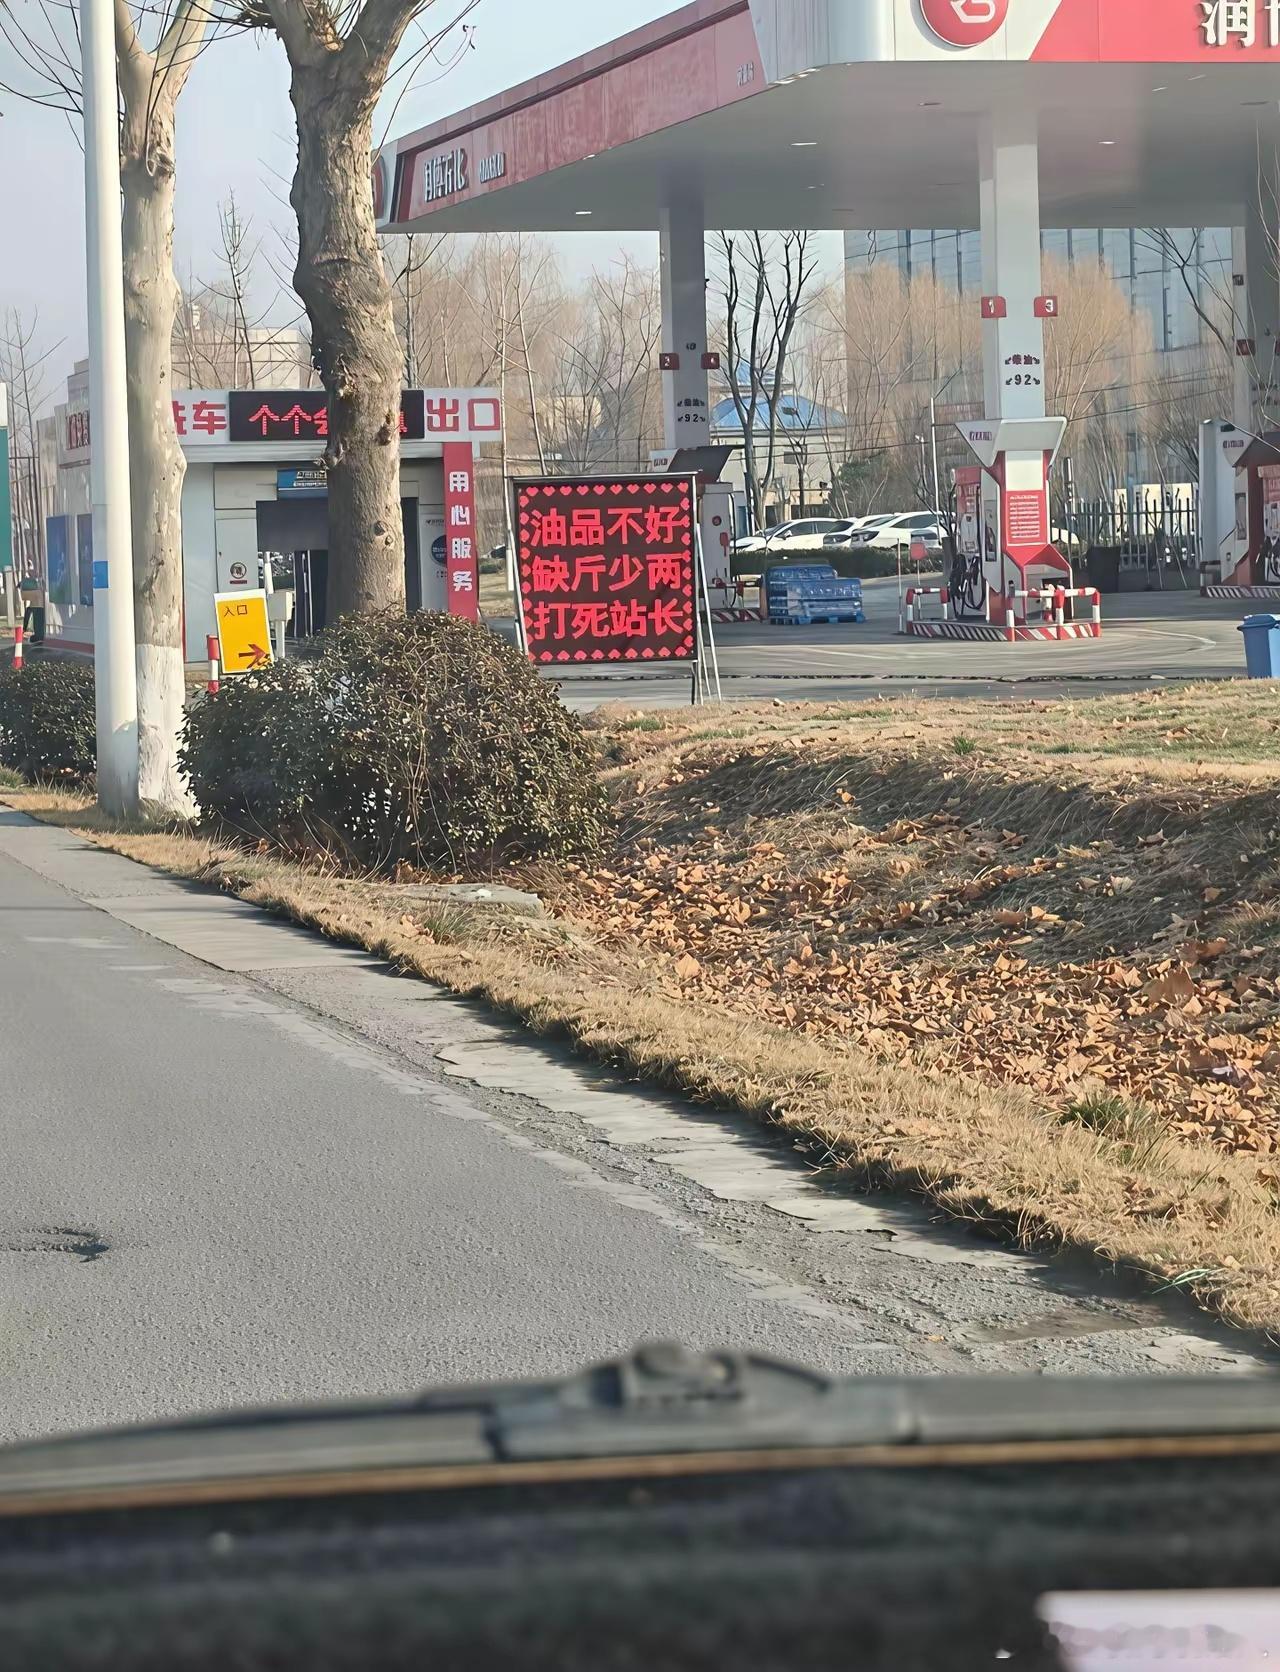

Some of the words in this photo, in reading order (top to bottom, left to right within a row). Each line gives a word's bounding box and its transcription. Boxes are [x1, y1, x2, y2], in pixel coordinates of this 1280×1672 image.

[1014, 374, 1032, 385] 92
[426, 398, 501, 432] 出口
[684, 413, 699, 422] 92
[449, 471, 473, 592] 用心服务
[530, 505, 684, 547] 油品不好
[532, 553, 683, 593] 缺斤少两
[224, 604, 248, 618] 入口
[533, 598, 684, 640] 打死站长
